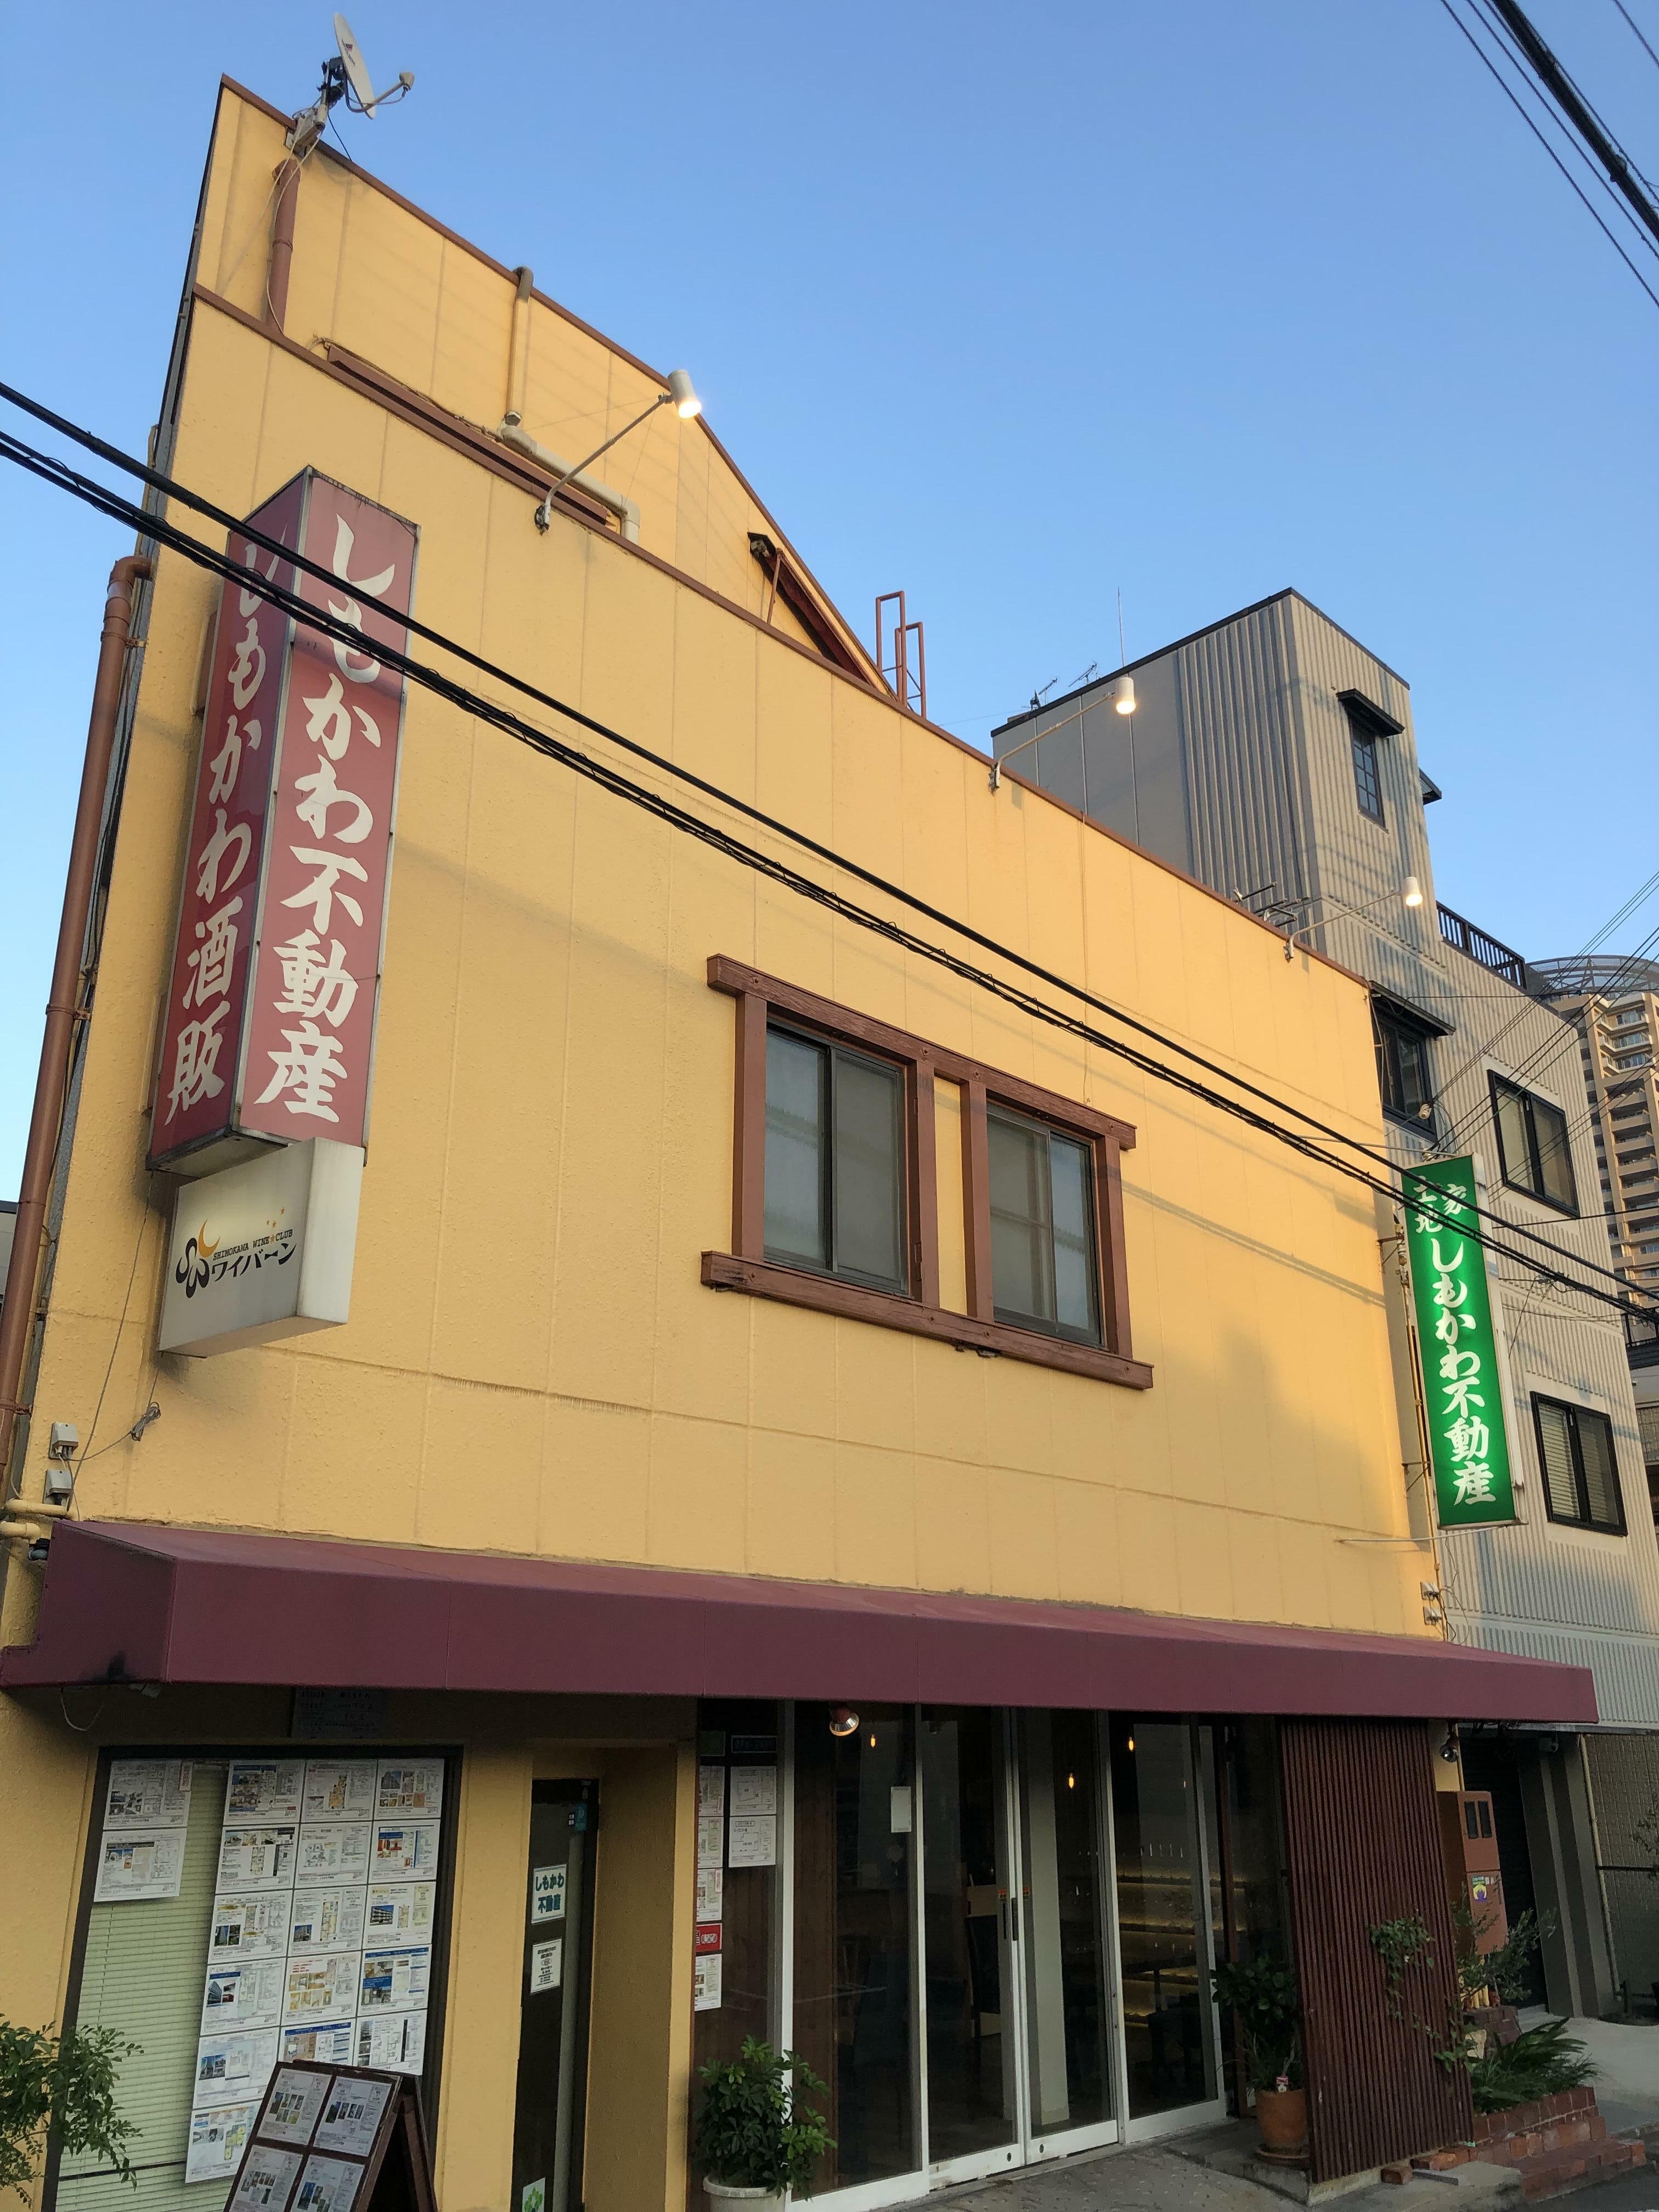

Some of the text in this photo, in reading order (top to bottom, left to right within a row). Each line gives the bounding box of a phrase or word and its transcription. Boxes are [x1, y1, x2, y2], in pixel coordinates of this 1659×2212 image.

[164, 524, 287, 1126] しもかわ酒販
[253, 514, 395, 1123] しもかわ不動産
[211, 1242, 297, 1282] ワイバーン
[213, 1229, 293, 1261] SHIMOKAWA WINE CLUB
[1441, 1183, 1469, 1215] 家
[1431, 1238, 1496, 1506] しもかわ不動産
